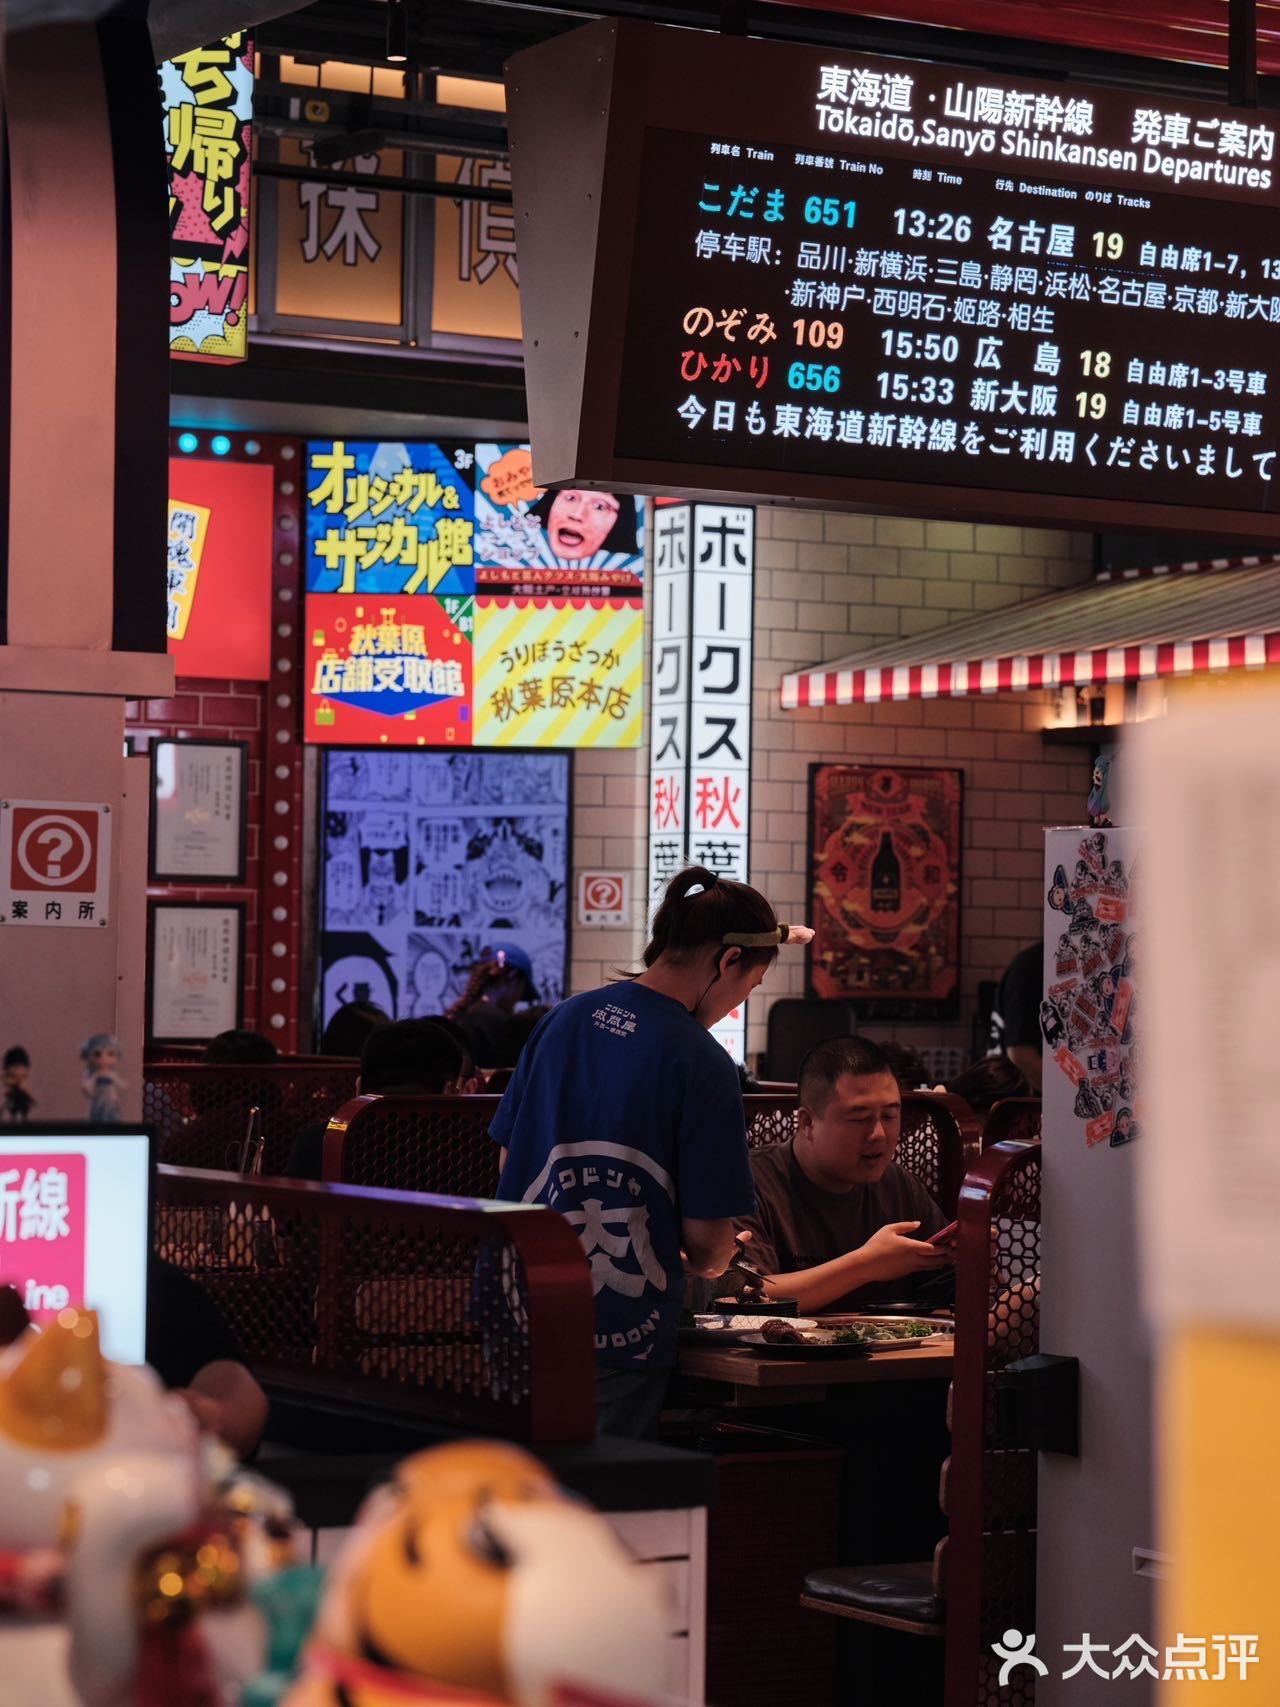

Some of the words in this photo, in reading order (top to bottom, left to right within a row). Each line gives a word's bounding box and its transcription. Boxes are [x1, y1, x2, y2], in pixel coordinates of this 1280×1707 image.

[1001, 130, 1137, 171] Shinkansen
[1143, 149, 1272, 189] Departures
[1131, 108, 1275, 161] 発車ご案内
[746, 147, 774, 162] Train
[839, 159, 866, 173] Train
[868, 164, 884, 175] No
[937, 171, 963, 185] Time
[995, 179, 1014, 192] 行先
[1018, 183, 1078, 200] Destination
[1085, 190, 1113, 204] のりば
[1117, 194, 1151, 209] Tracks
[698, 183, 785, 222] こだま
[804, 196, 857, 229] 651
[893, 208, 973, 243] 13:26
[986, 216, 1076, 259] 名古屋
[1092, 230, 1124, 260] 19
[682, 306, 777, 345] のぞみ
[792, 318, 845, 350] 109
[881, 329, 959, 363] 15:50
[1079, 349, 1112, 378] 18
[680, 350, 769, 389] ひかり
[787, 361, 841, 393] 656
[877, 372, 955, 406] 15:33
[970, 377, 1058, 417] 新大阪
[1075, 391, 1107, 420] 19
[454, 449, 474, 470] 3F
[314, 517, 474, 594] サブカル館
[500, 639, 620, 674] うりぼうざっか
[491, 675, 631, 723] 秋葉原本店
[11, 900, 95, 920] 案内所
[24, 1278, 70, 1311] ine
